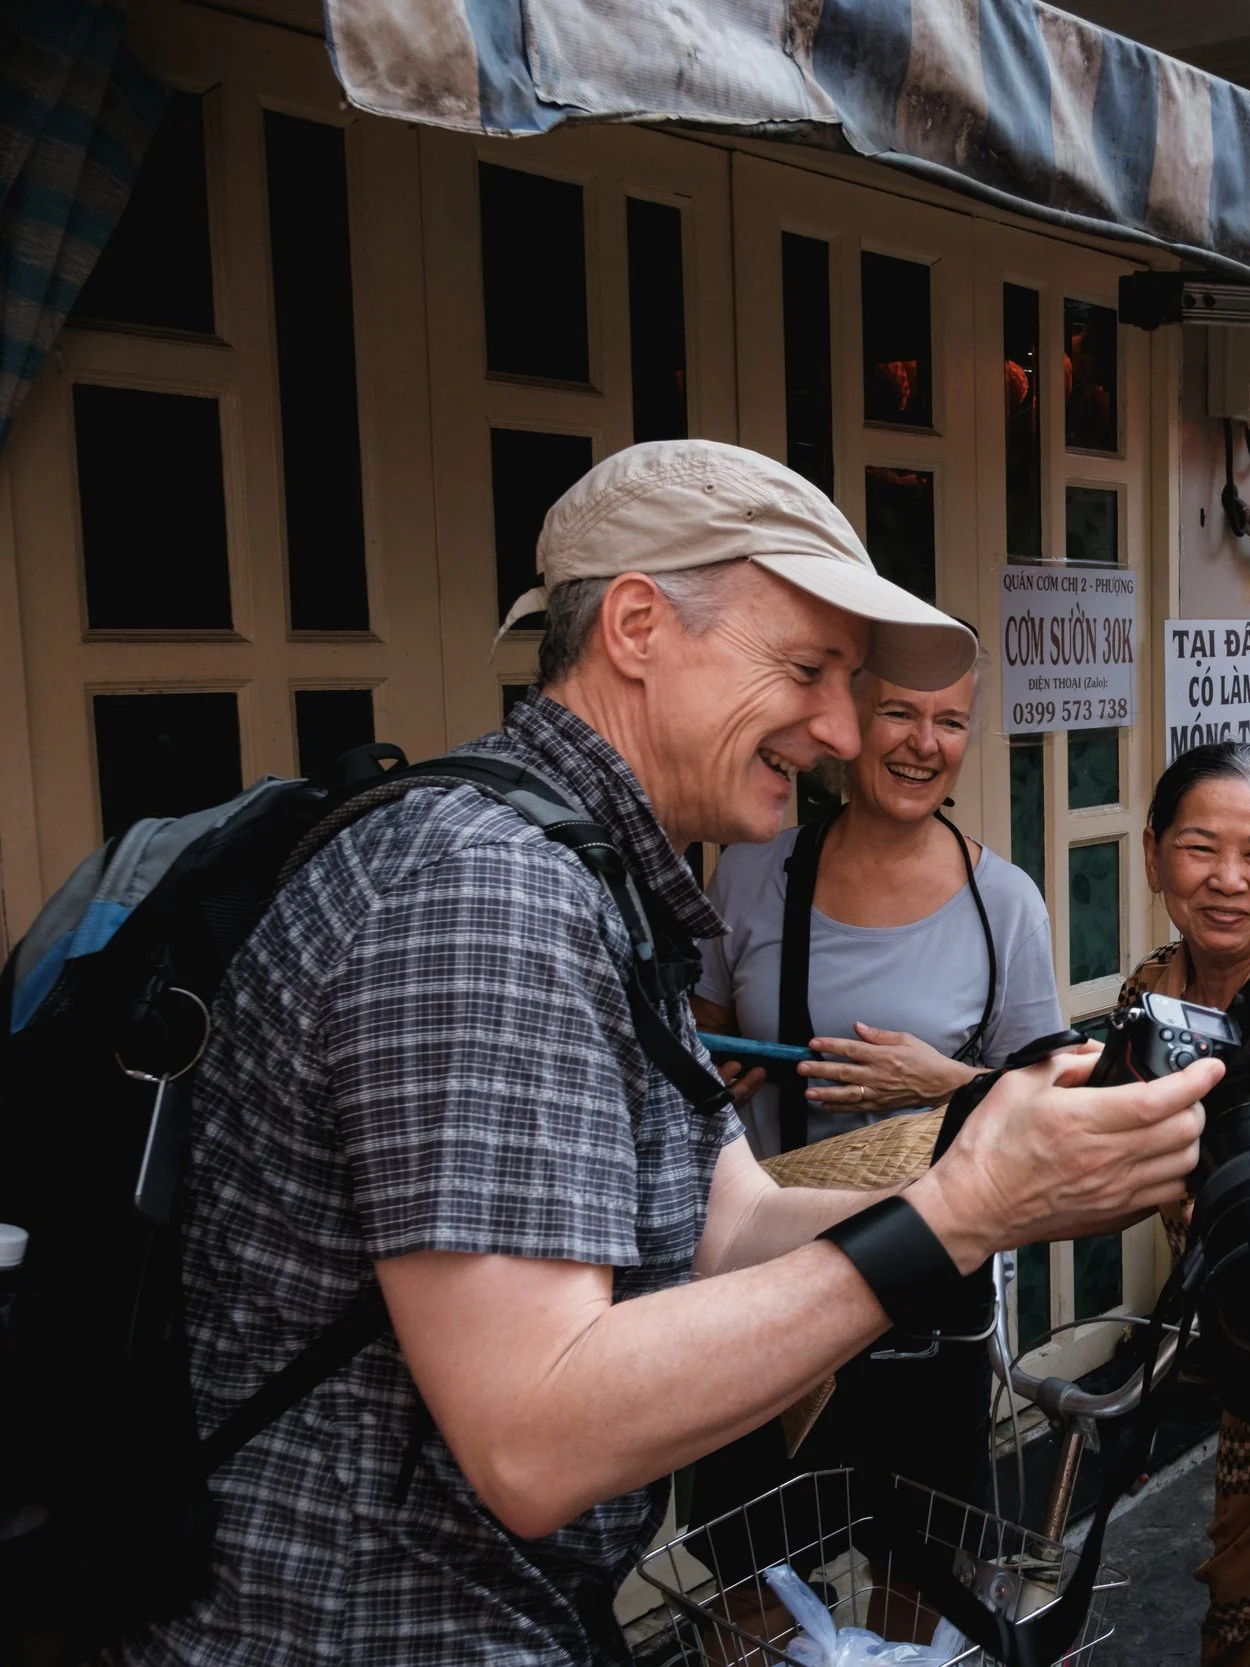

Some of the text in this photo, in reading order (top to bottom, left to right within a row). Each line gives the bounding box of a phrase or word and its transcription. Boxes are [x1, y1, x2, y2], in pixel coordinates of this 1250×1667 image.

[1003, 570, 1033, 592] QUÁN
[1036, 574, 1058, 591] CƠM
[1061, 577, 1078, 595] CHỊ
[1081, 578, 1087, 592] 2
[1095, 576, 1134, 596] PHƯỢNG
[1005, 602, 1133, 666] CƠM SƯỜN 30K
[1172, 629, 1216, 667] TẠI
[1028, 675, 1108, 692] ĐIỆN THOẠI (Zalo):
[1188, 666, 1213, 707] CÓ
[1013, 698, 1127, 725] 0399 573 738
